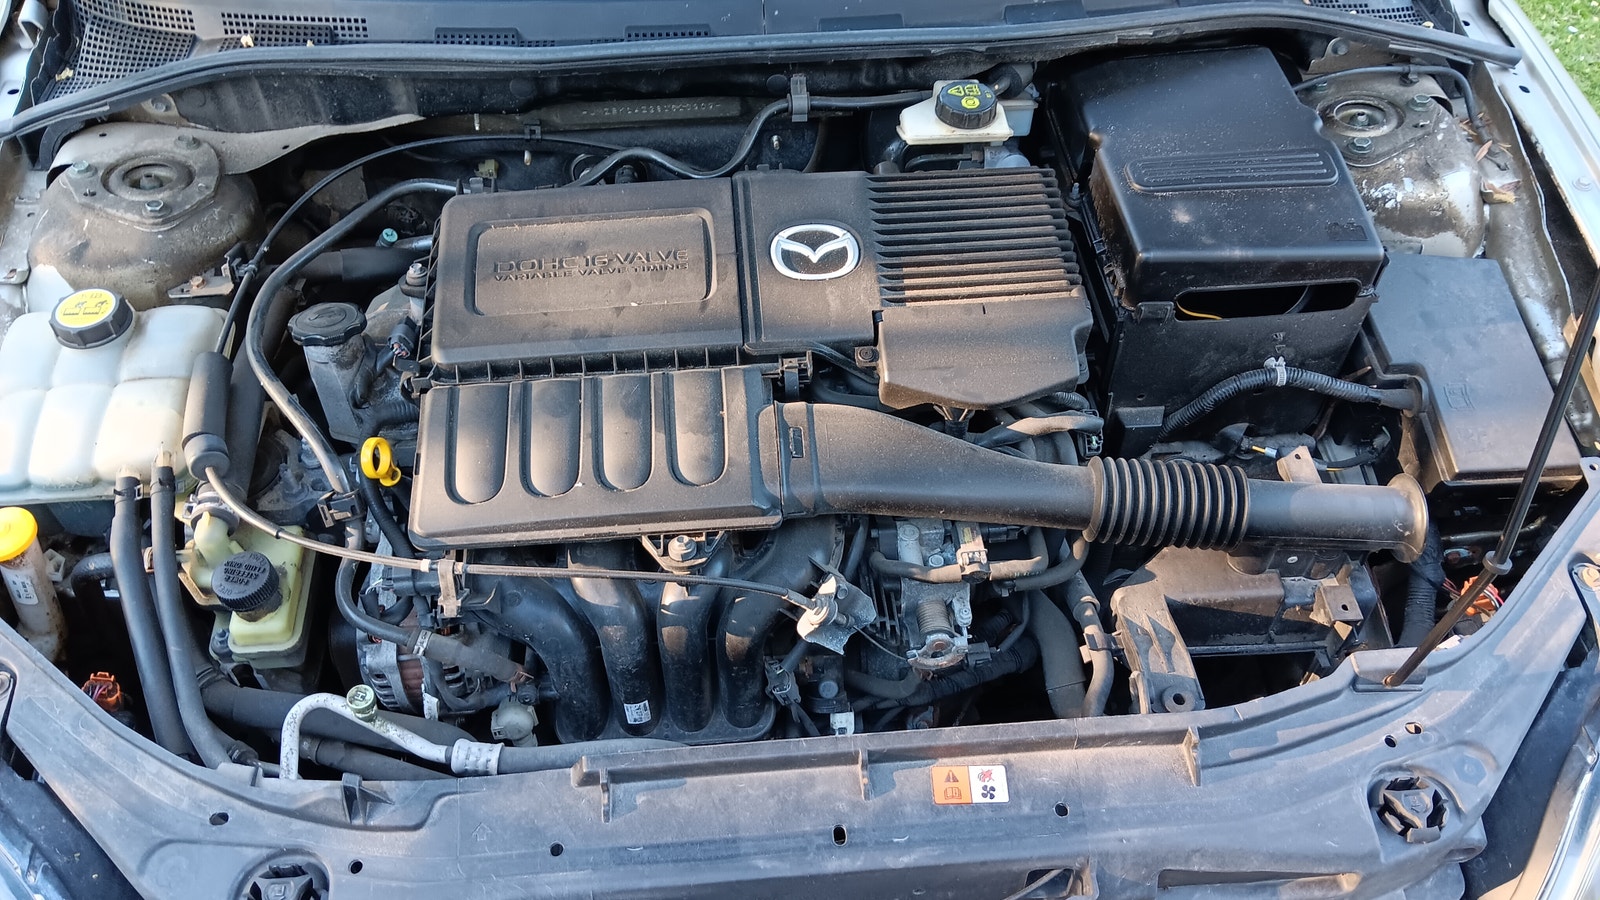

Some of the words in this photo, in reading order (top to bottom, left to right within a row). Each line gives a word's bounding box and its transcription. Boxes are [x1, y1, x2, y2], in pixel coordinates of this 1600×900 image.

[494, 256, 579, 273] DOHC
[583, 249, 688, 267] 16-VALVE
[495, 270, 573, 281] VARIABLE
[580, 266, 629, 277] VALVE
[633, 262, 688, 273] TIMING
